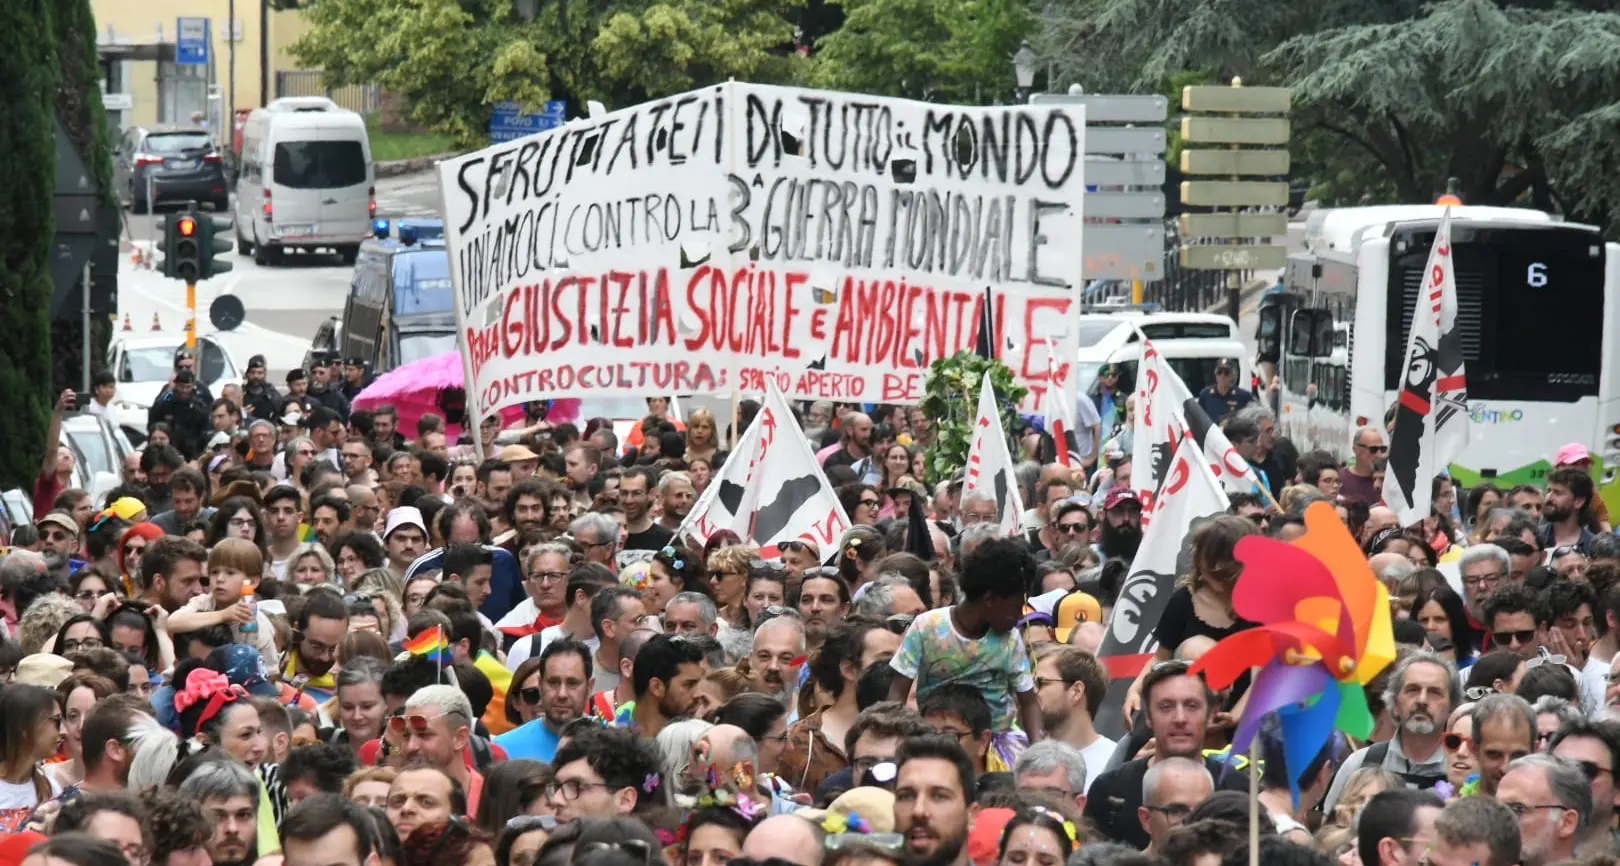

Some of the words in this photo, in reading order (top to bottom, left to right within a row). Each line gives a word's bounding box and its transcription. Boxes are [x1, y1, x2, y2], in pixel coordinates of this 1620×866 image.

[798, 97, 892, 175] TUTTO
[923, 109, 1077, 189] MONDO
[563, 194, 681, 255] CONTRO
[691, 196, 720, 232] LA
[761, 176, 878, 268] GUERRA
[886, 189, 1073, 290] MONDIALE
[1527, 263, 1548, 287] 6
[502, 266, 676, 359] GIUSTIZIA
[684, 263, 809, 358] SOCiALE
[795, 371, 866, 398] APERTO
